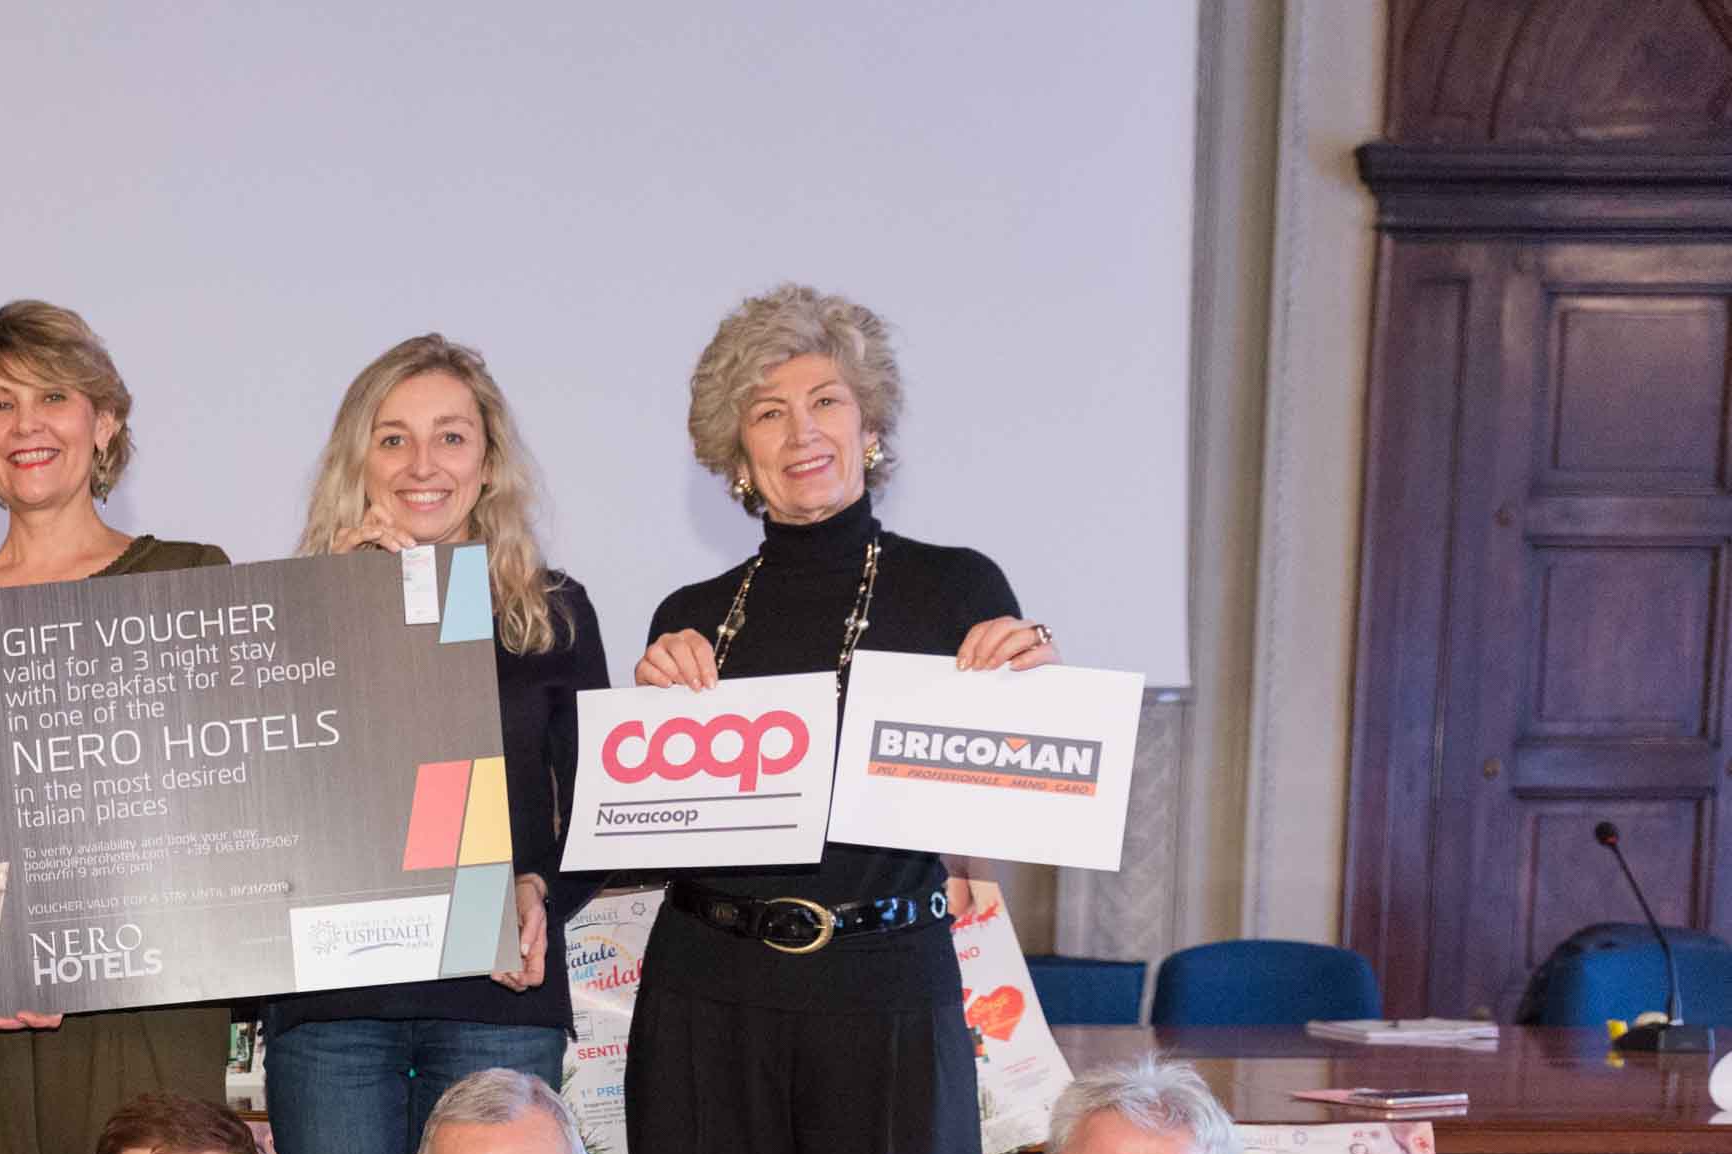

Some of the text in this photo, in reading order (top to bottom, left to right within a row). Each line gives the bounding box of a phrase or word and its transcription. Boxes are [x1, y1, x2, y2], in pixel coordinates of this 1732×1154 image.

[2, 603, 276, 657] GIFT VOUCHER
[3, 639, 277, 684] valid for a 3 night stay
[5, 656, 337, 708] with breakfast for 2 people
[8, 698, 165, 733] in one of the
[13, 709, 341, 776] NERO HOTELS
[601, 710, 810, 792] coop
[877, 728, 1093, 777] BRICOMAN
[14, 761, 247, 804] in the most desired
[17, 797, 168, 832] Italian places
[596, 805, 699, 826] Novacoop
[23, 847, 37, 859] To
[40, 844, 73, 861] verify
[77, 837, 137, 857] availability
[141, 835, 164, 849] and
[201, 831, 228, 846] your
[78, 866, 87, 878] 9
[28, 898, 84, 915] VOUCHER
[86, 896, 118, 910] VALID
[29, 924, 143, 959] NERO
[571, 944, 617, 968] atale
[33, 949, 163, 986] HOTELS
[577, 1044, 620, 1060] SENTI
